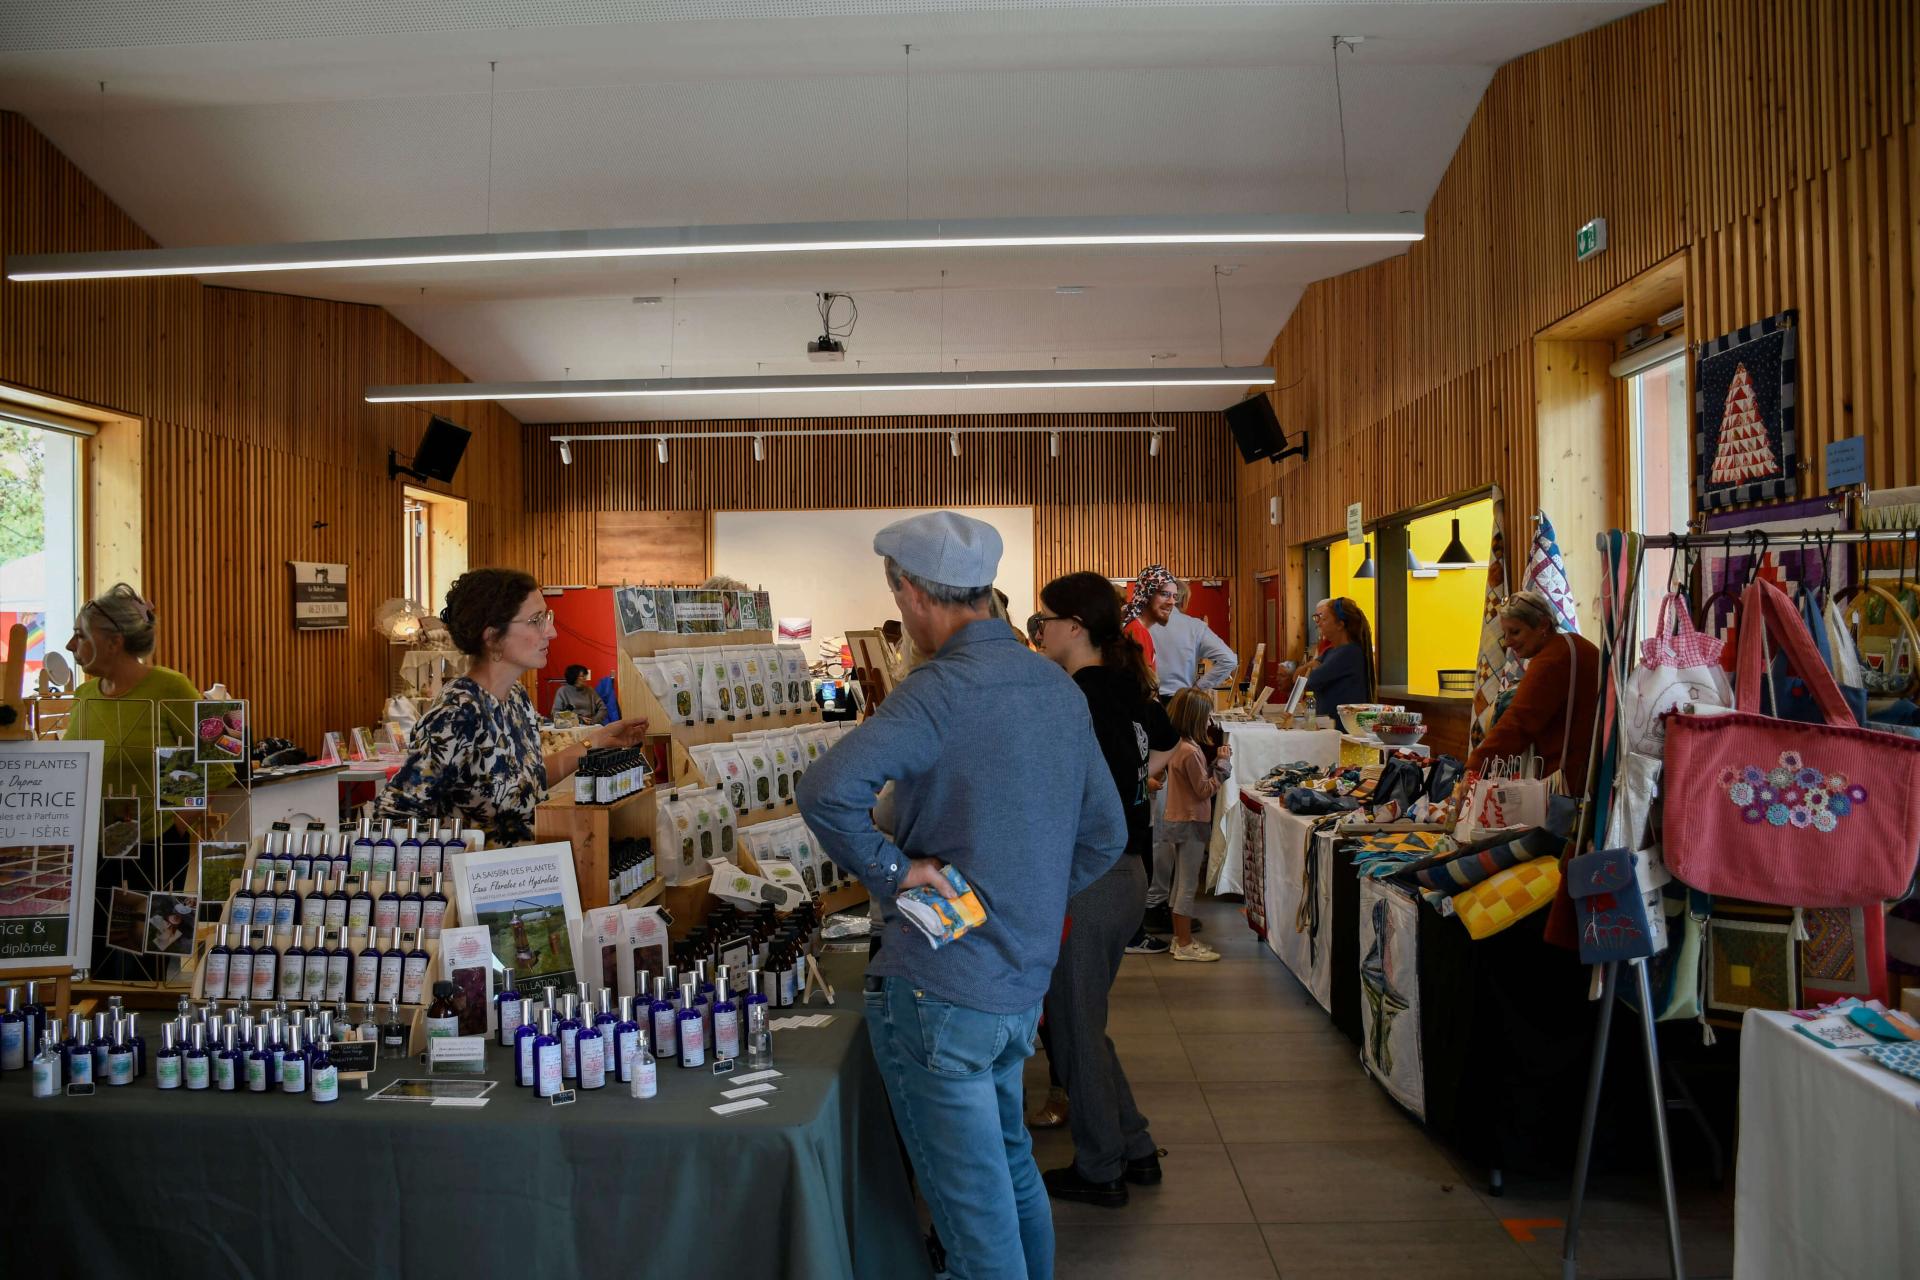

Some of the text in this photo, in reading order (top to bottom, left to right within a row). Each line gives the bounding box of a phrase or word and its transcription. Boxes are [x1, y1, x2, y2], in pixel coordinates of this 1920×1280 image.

[24, 759, 77, 769] PLANTES
[33, 812, 70, 820] Parfums
[32, 824, 72, 838] ISÈRE
[482, 868, 509, 880] SAISON
[510, 867, 525, 876] DES
[525, 862, 557, 873] PLANTES
[33, 921, 46, 934] &
[1, 942, 57, 956] diplômée
[518, 976, 561, 992] TILLATION
